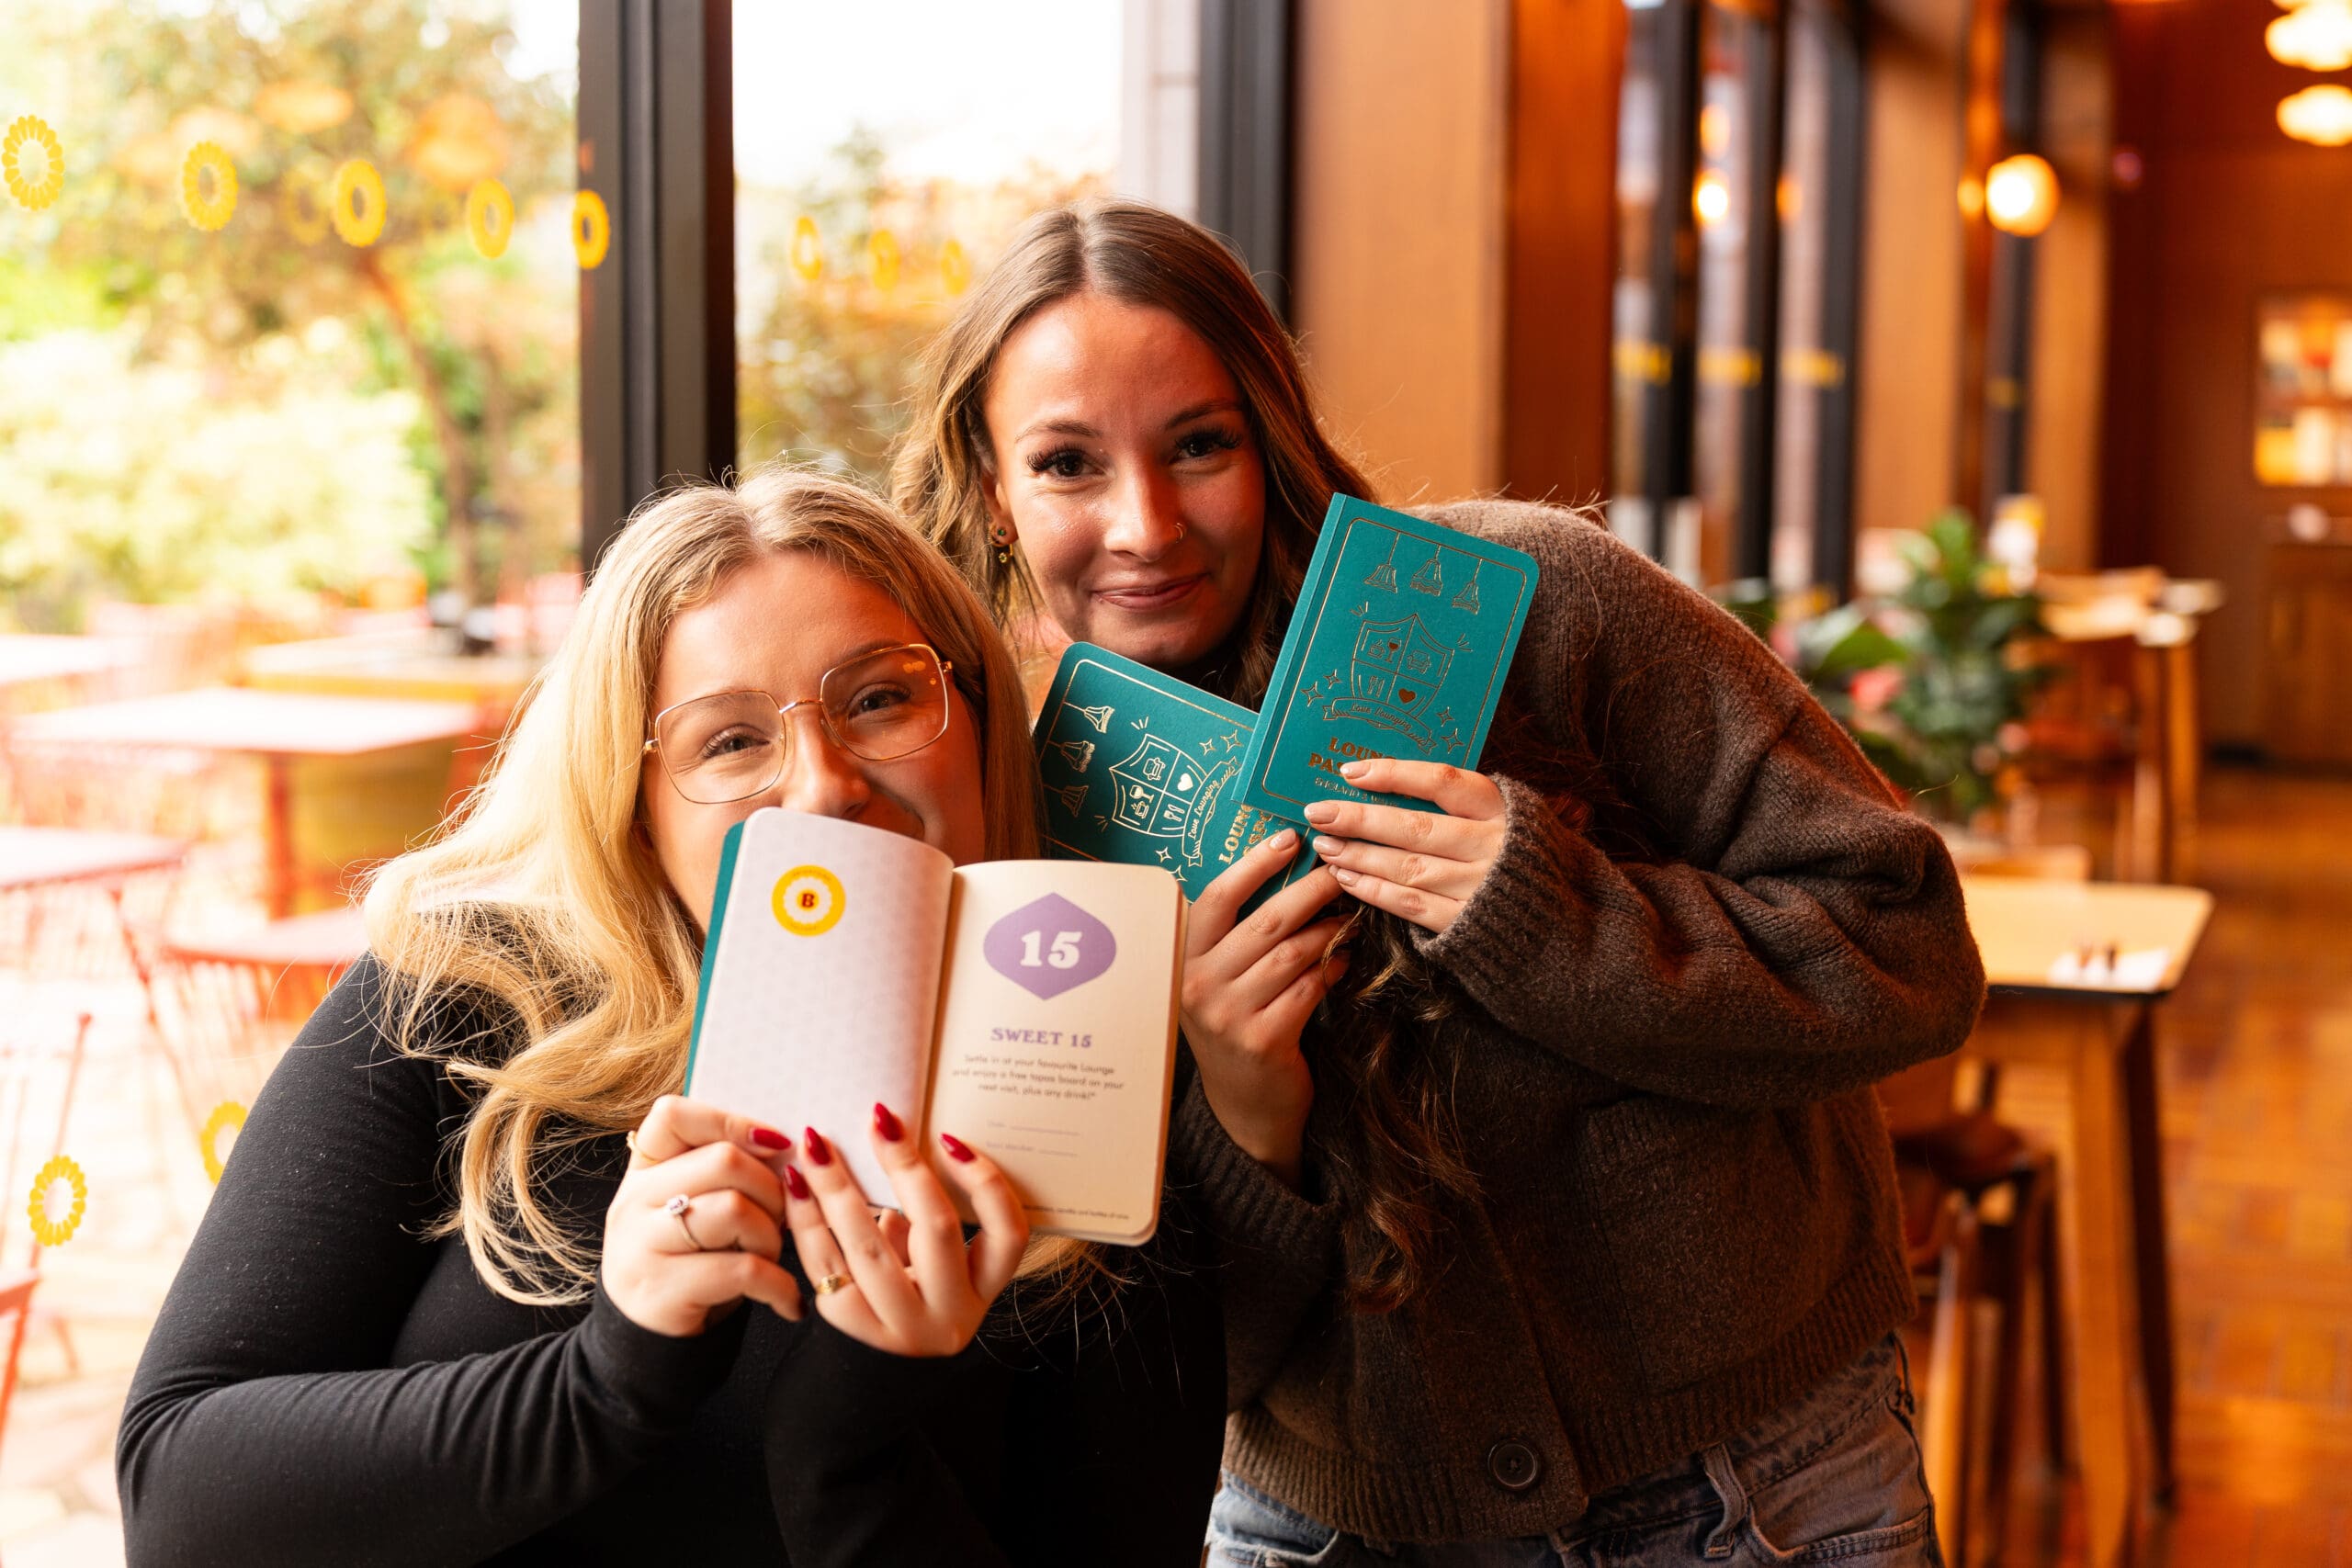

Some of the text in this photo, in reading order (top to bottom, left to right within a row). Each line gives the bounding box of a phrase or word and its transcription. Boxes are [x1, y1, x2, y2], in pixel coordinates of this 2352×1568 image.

[1351, 703, 1412, 731] Love Lounging
[1315, 777, 1360, 797] ENGLAND
[1188, 780, 1220, 840] Love Lounging
[802, 893, 815, 908] B
[1020, 930, 1082, 969] 15
[990, 1028, 1092, 1048] SWEET 15
[1037, 1058, 1078, 1071] favourite
[1080, 1063, 1114, 1076] Lounge
[1009, 1070, 1026, 1079] free
[1058, 1075, 1086, 1086] board
[1103, 1080, 1125, 1090] your
[1022, 1086, 1042, 1096] plus
[1044, 1089, 1061, 1099] any
